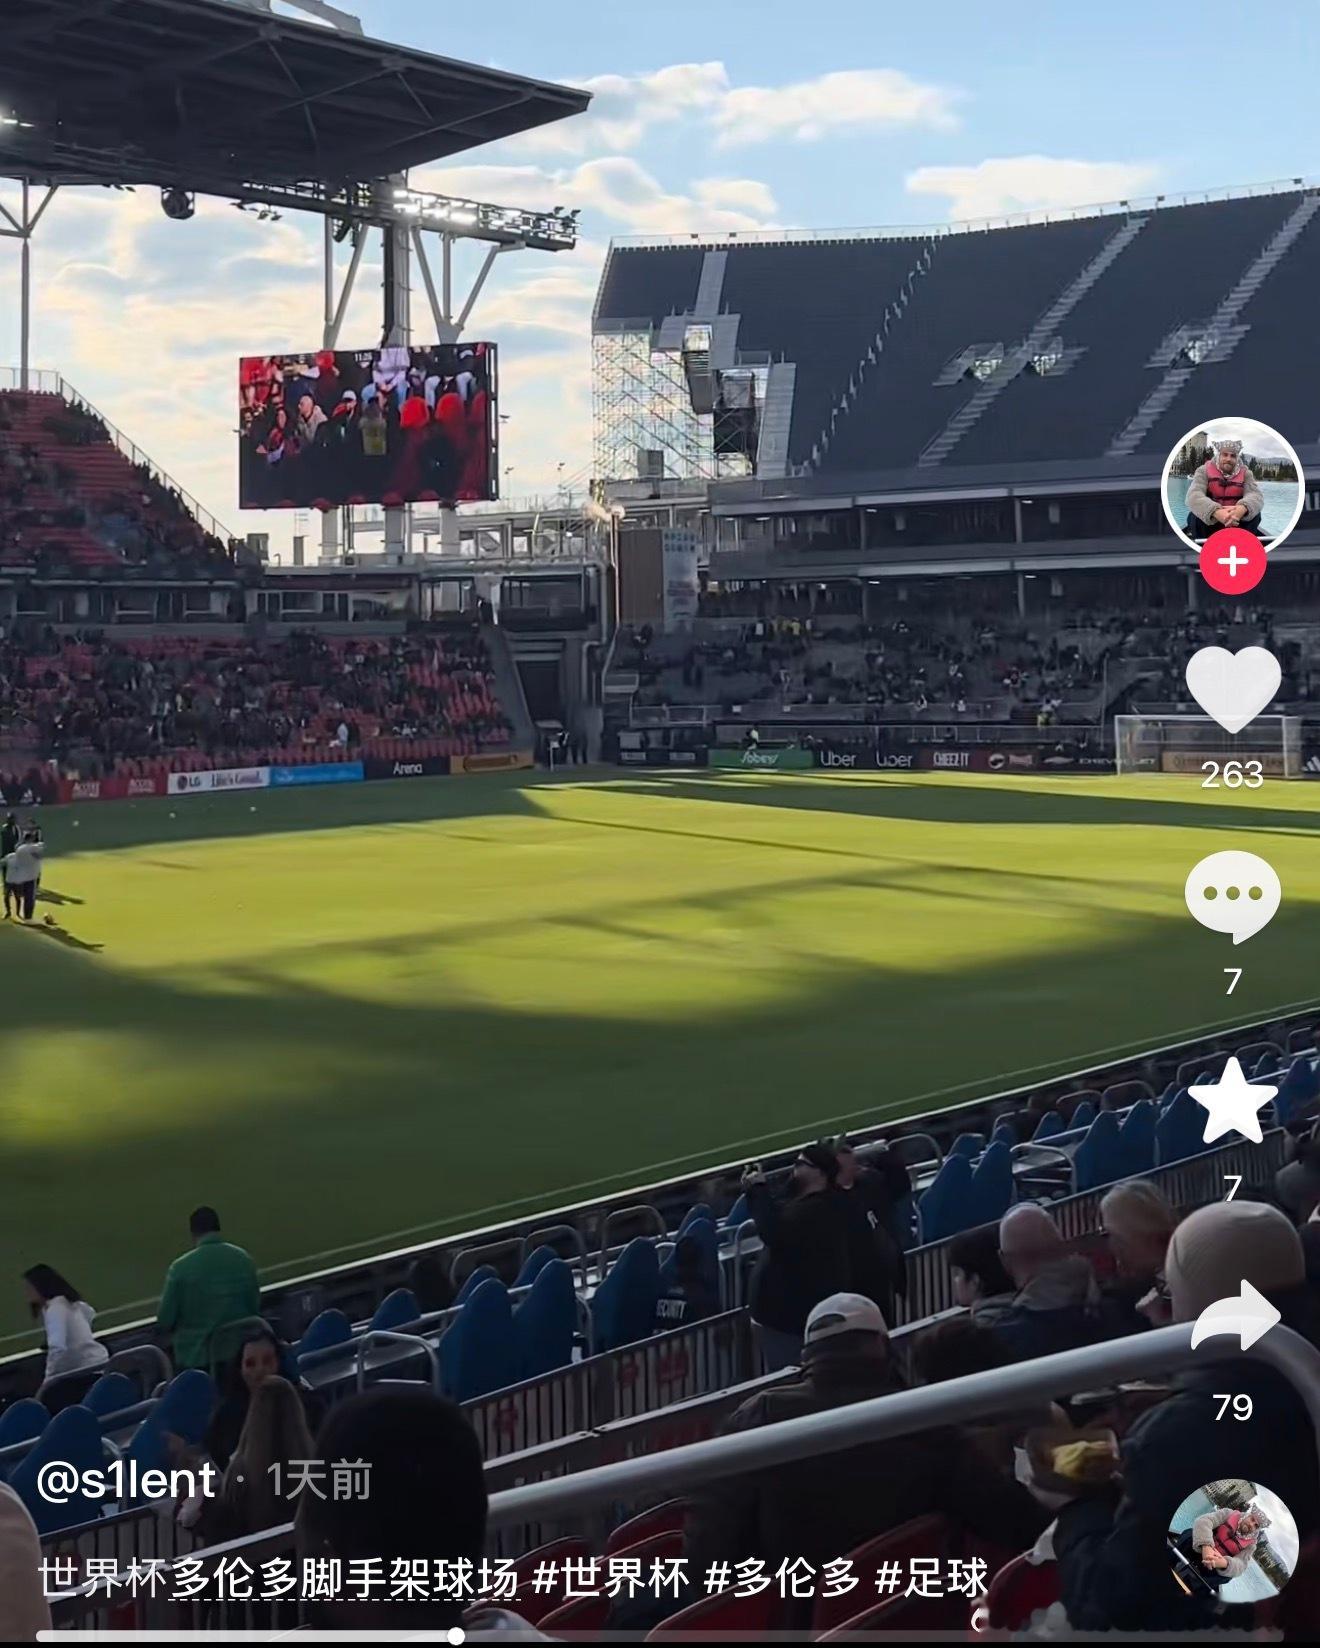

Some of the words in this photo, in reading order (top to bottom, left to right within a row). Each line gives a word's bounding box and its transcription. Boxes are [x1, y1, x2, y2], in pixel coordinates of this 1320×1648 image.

[820, 751, 857, 767] Uber
[393, 761, 423, 775] Arena
[188, 776, 201, 788] LG
